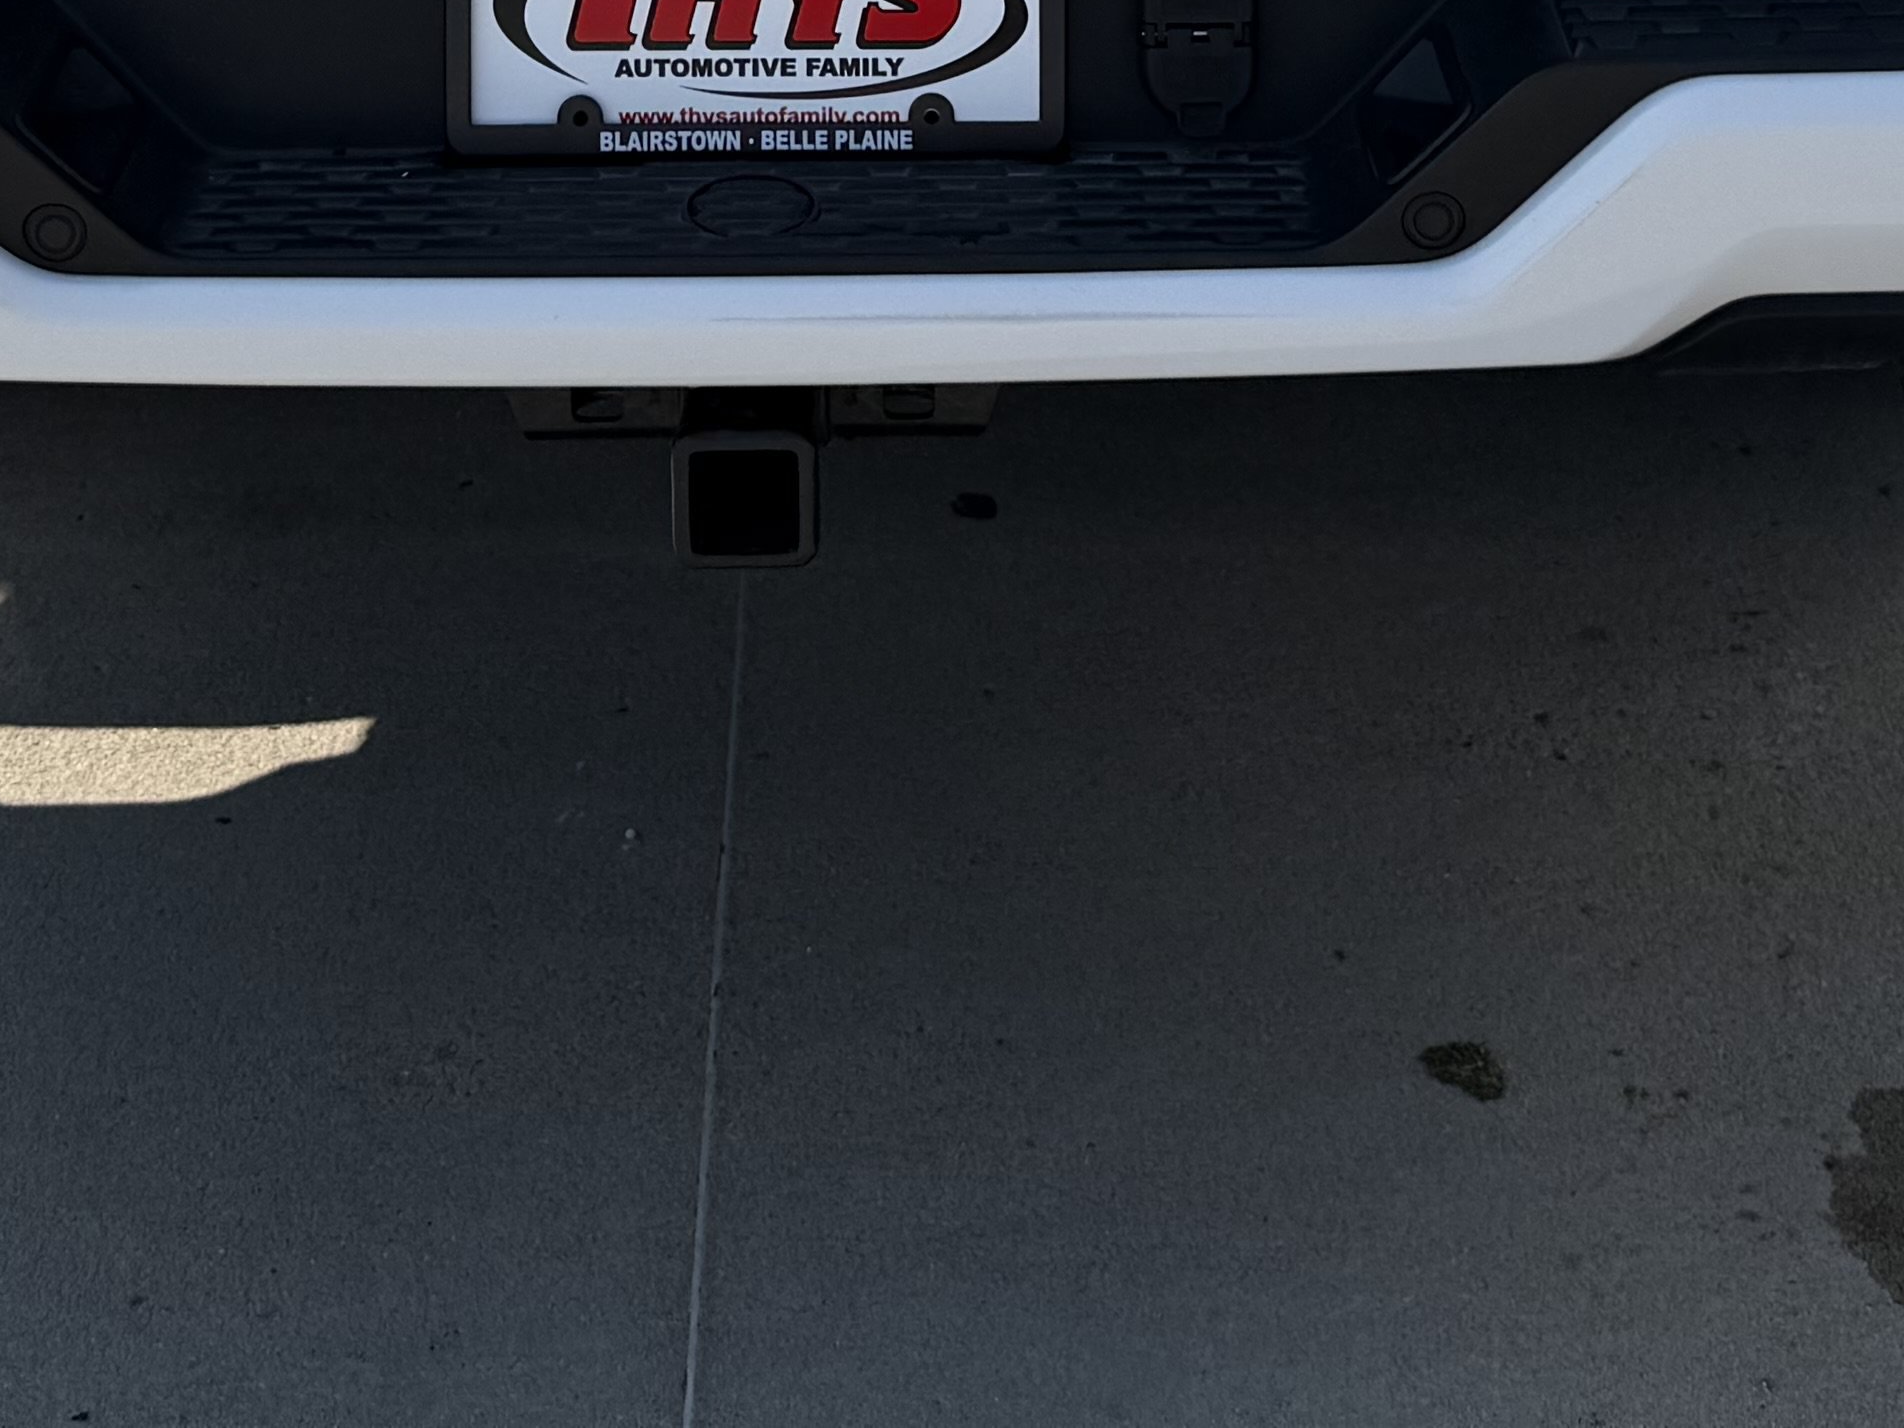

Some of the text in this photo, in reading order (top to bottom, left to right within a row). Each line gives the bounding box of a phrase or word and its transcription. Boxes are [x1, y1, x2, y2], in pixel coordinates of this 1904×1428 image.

[614, 57, 905, 78] AUTOMOTIVE FAMILY
[599, 130, 914, 152] BLAIRSTOWN BELLE PLAINE
